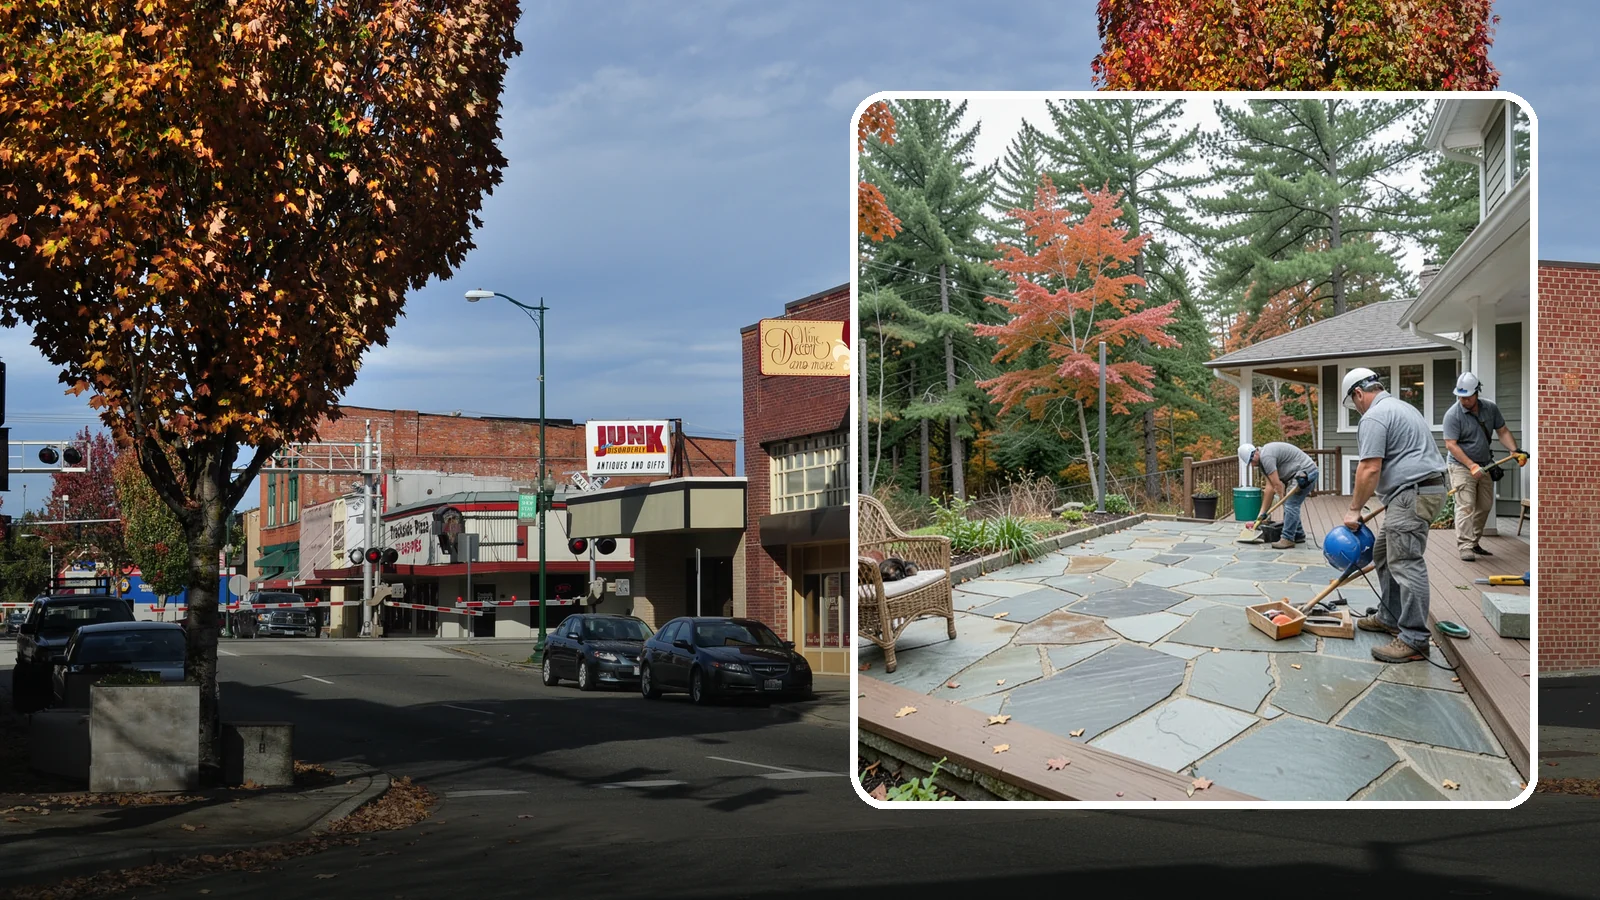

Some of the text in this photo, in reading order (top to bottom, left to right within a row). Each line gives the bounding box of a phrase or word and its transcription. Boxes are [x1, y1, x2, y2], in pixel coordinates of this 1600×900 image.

[595, 425, 665, 457] JUNK
[597, 461, 665, 470] ANTIQUES AND GIFTS
[390, 519, 429, 540] Trackside Pizza
